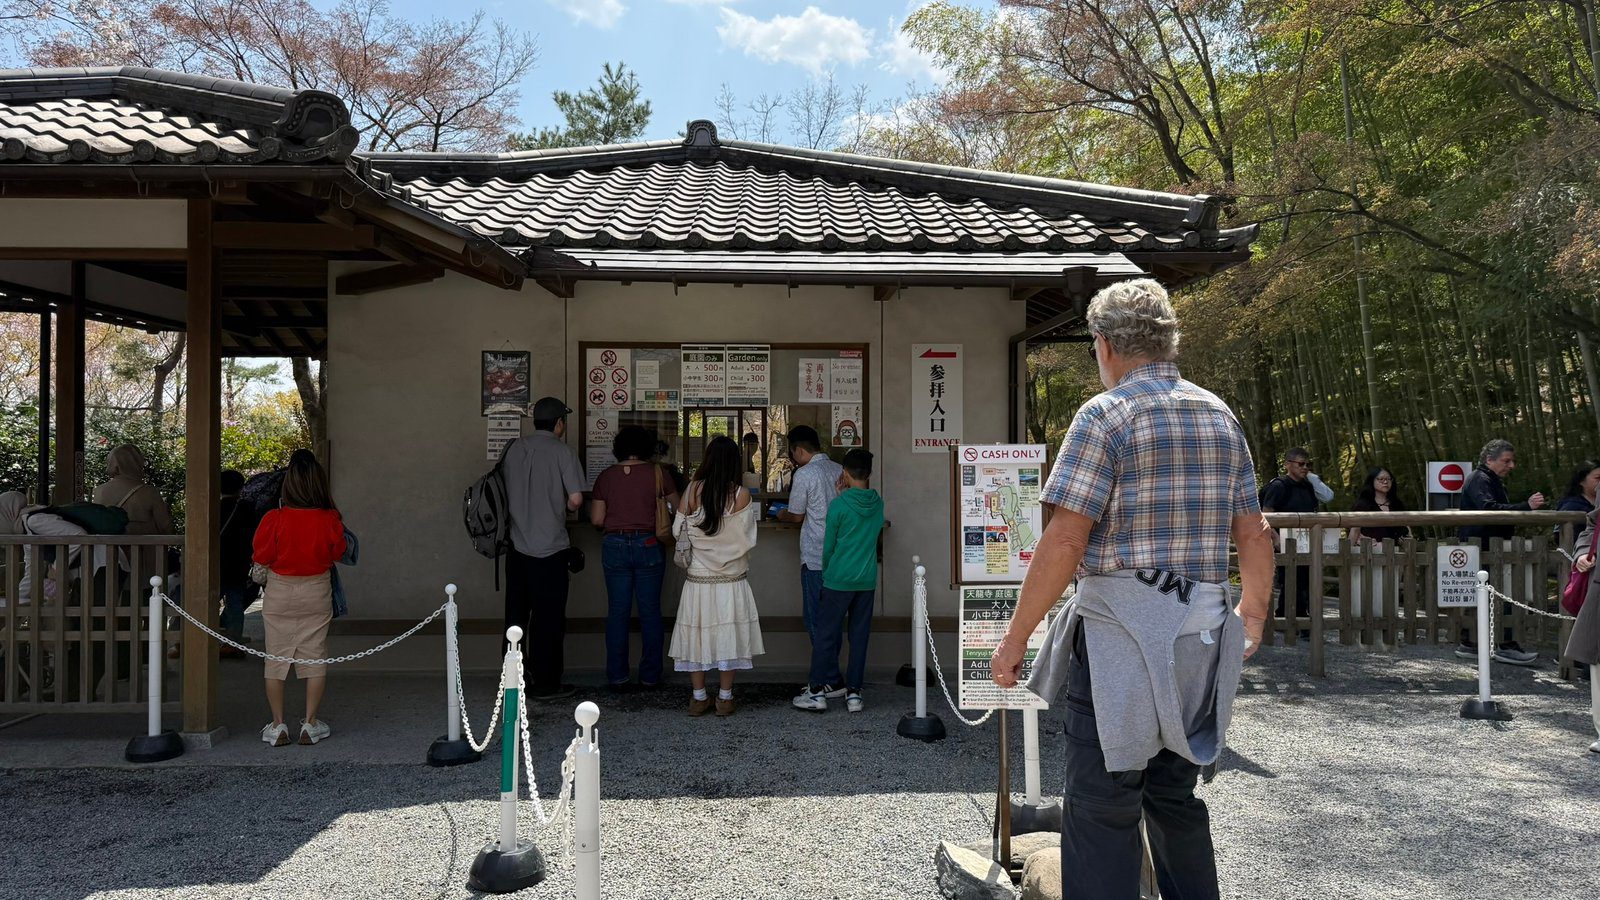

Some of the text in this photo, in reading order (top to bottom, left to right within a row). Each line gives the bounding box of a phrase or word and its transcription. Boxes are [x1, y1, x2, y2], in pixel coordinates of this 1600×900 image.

[728, 353, 756, 362] Garden
[815, 363, 825, 399] 再入場は
[929, 364, 946, 433] 参拝入口
[915, 438, 961, 447] ENTRANCE
[981, 449, 1041, 460] CASH ONLY
[966, 590, 1014, 600] 天龍寺 庭園
[991, 600, 1011, 609] 大人
[971, 611, 1011, 620] 小中学生
[966, 650, 988, 658] Tenryuji
[970, 660, 992, 669] Adul
